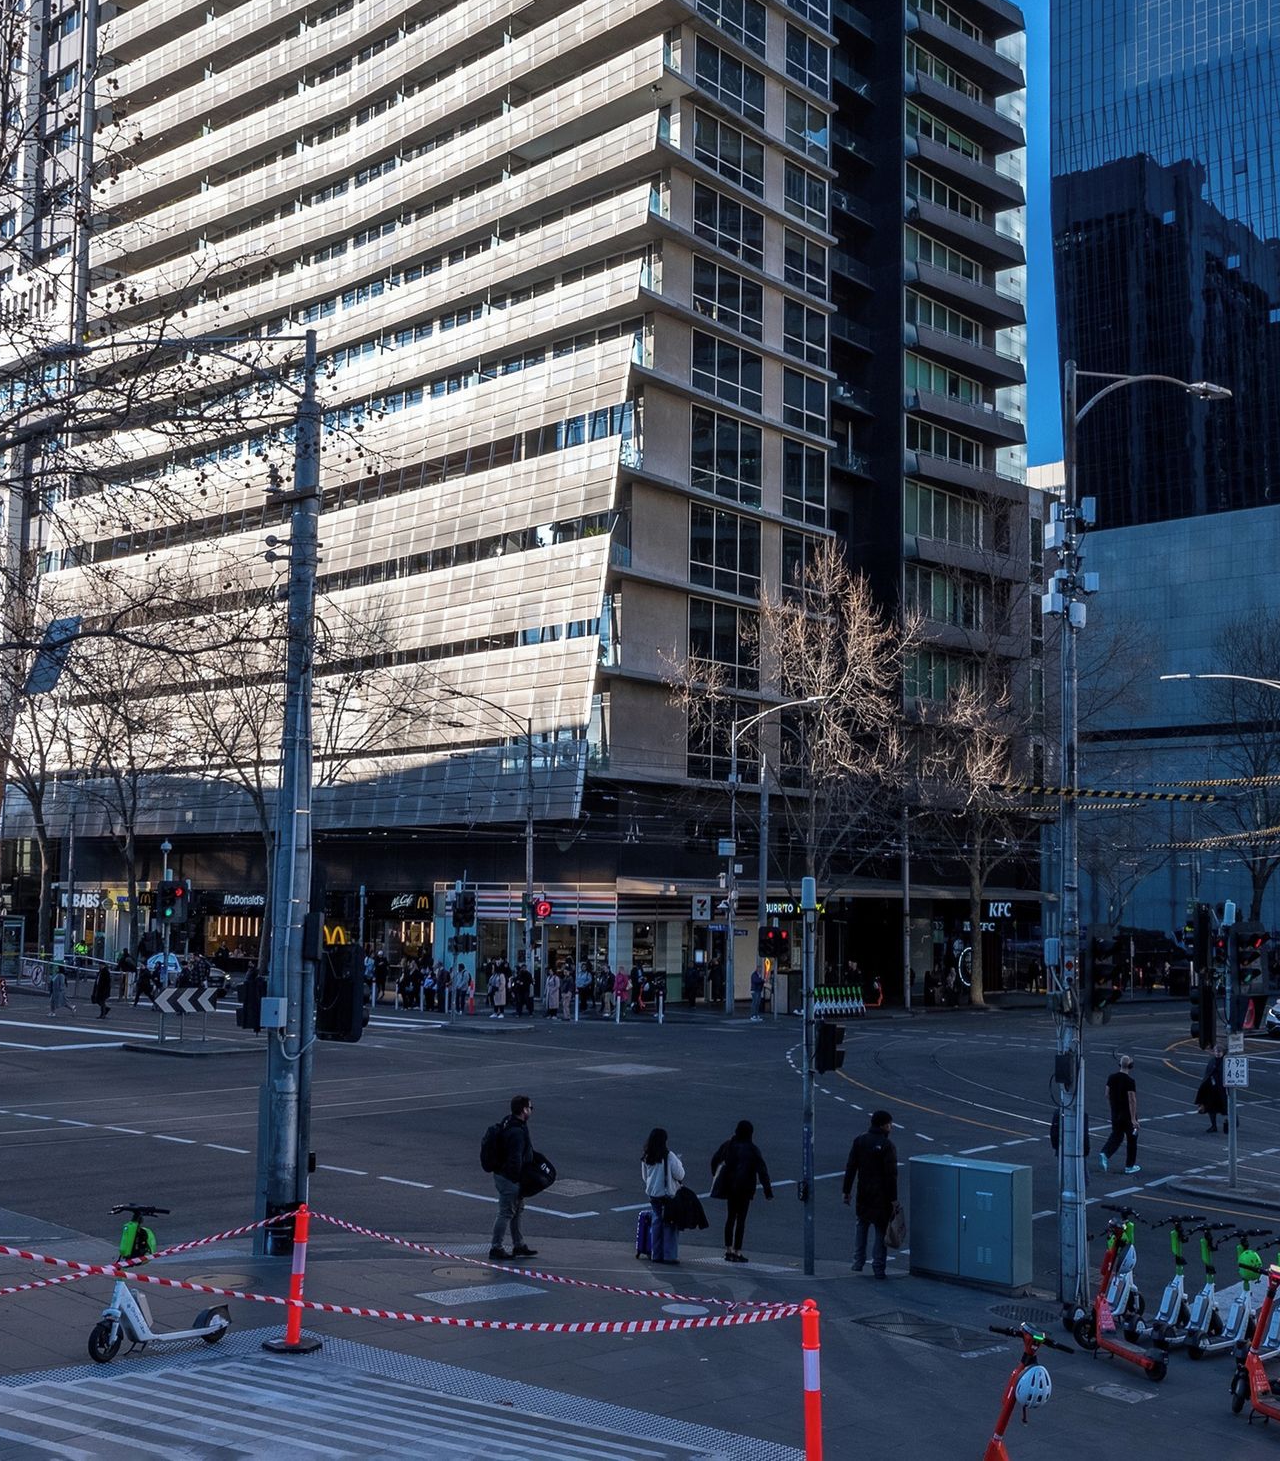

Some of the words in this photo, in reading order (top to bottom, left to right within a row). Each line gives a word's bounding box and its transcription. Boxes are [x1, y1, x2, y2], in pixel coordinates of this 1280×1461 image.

[61, 893, 100, 909] KBABS
[223, 894, 265, 906] McDonald's
[989, 902, 1012, 917] KFC
